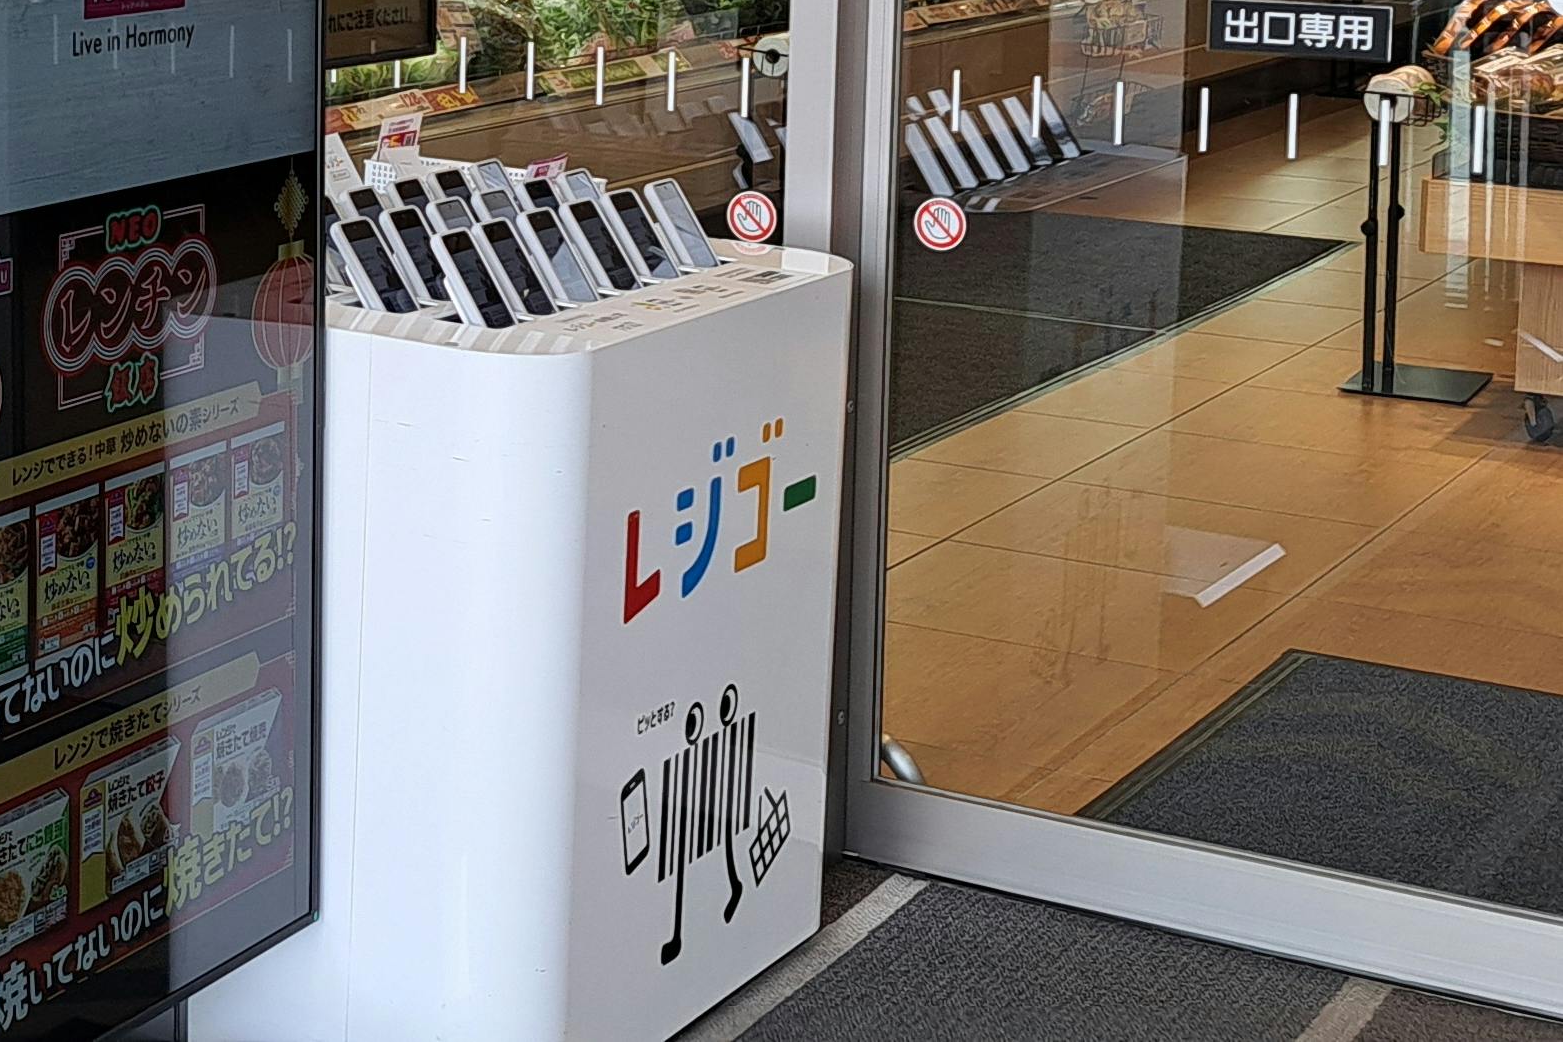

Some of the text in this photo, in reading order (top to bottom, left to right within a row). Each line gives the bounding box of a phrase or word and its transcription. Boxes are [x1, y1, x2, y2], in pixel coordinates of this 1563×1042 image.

[72, 22, 195, 57] Live in Harmony
[1224, 8, 1374, 51] 出口専用
[110, 211, 158, 246] NEO
[60, 265, 207, 354] レンチン
[11, 440, 117, 488] レンジでできる!中華
[624, 417, 816, 624] レジゴー
[115, 520, 297, 667] 炒められてる!?
[53, 685, 202, 769] レンジで焼きたてシリーズ
[163, 785, 295, 917] 焼きたて!?
